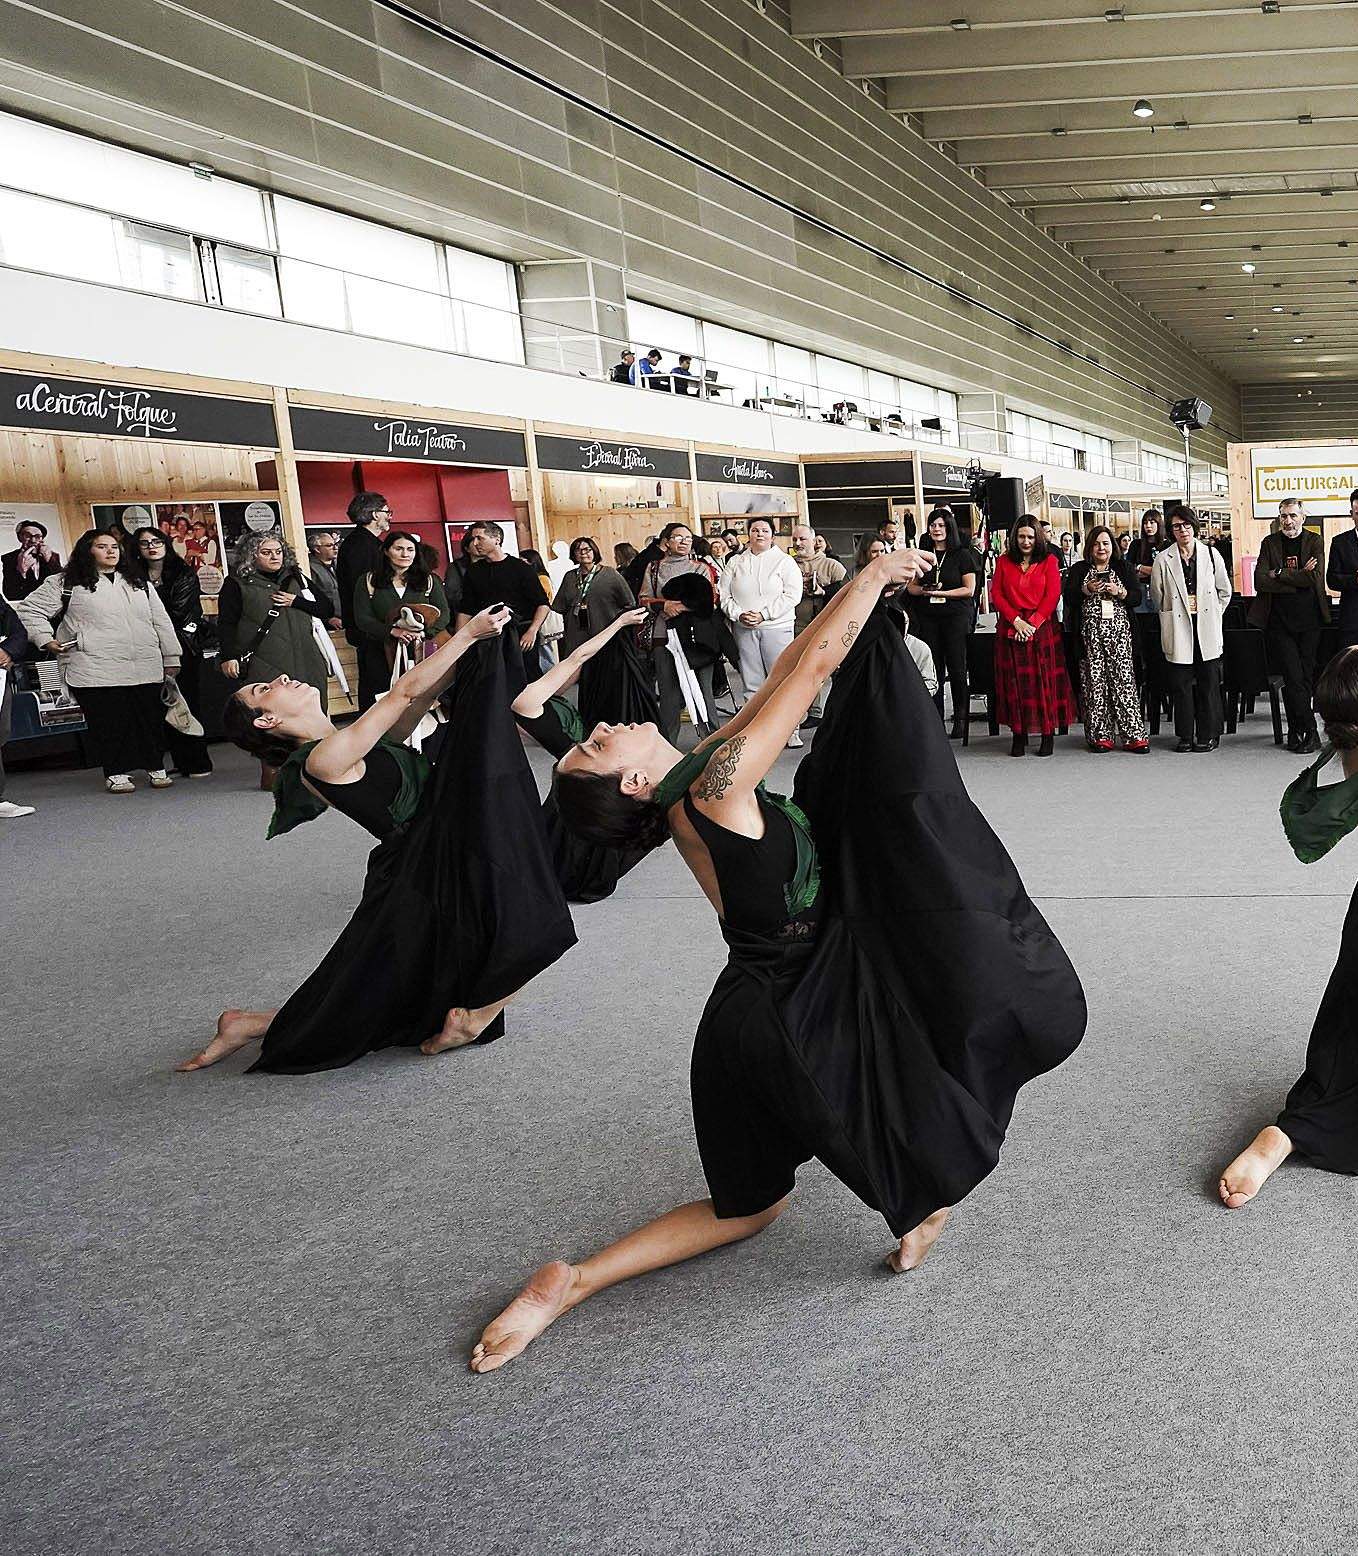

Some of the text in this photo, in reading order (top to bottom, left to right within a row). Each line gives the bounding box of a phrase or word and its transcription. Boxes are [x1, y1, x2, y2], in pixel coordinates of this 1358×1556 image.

[107, 391, 178, 437] Folque
[373, 421, 466, 456] Talia Teatro
[1263, 475, 1358, 492] CULTURGAL
